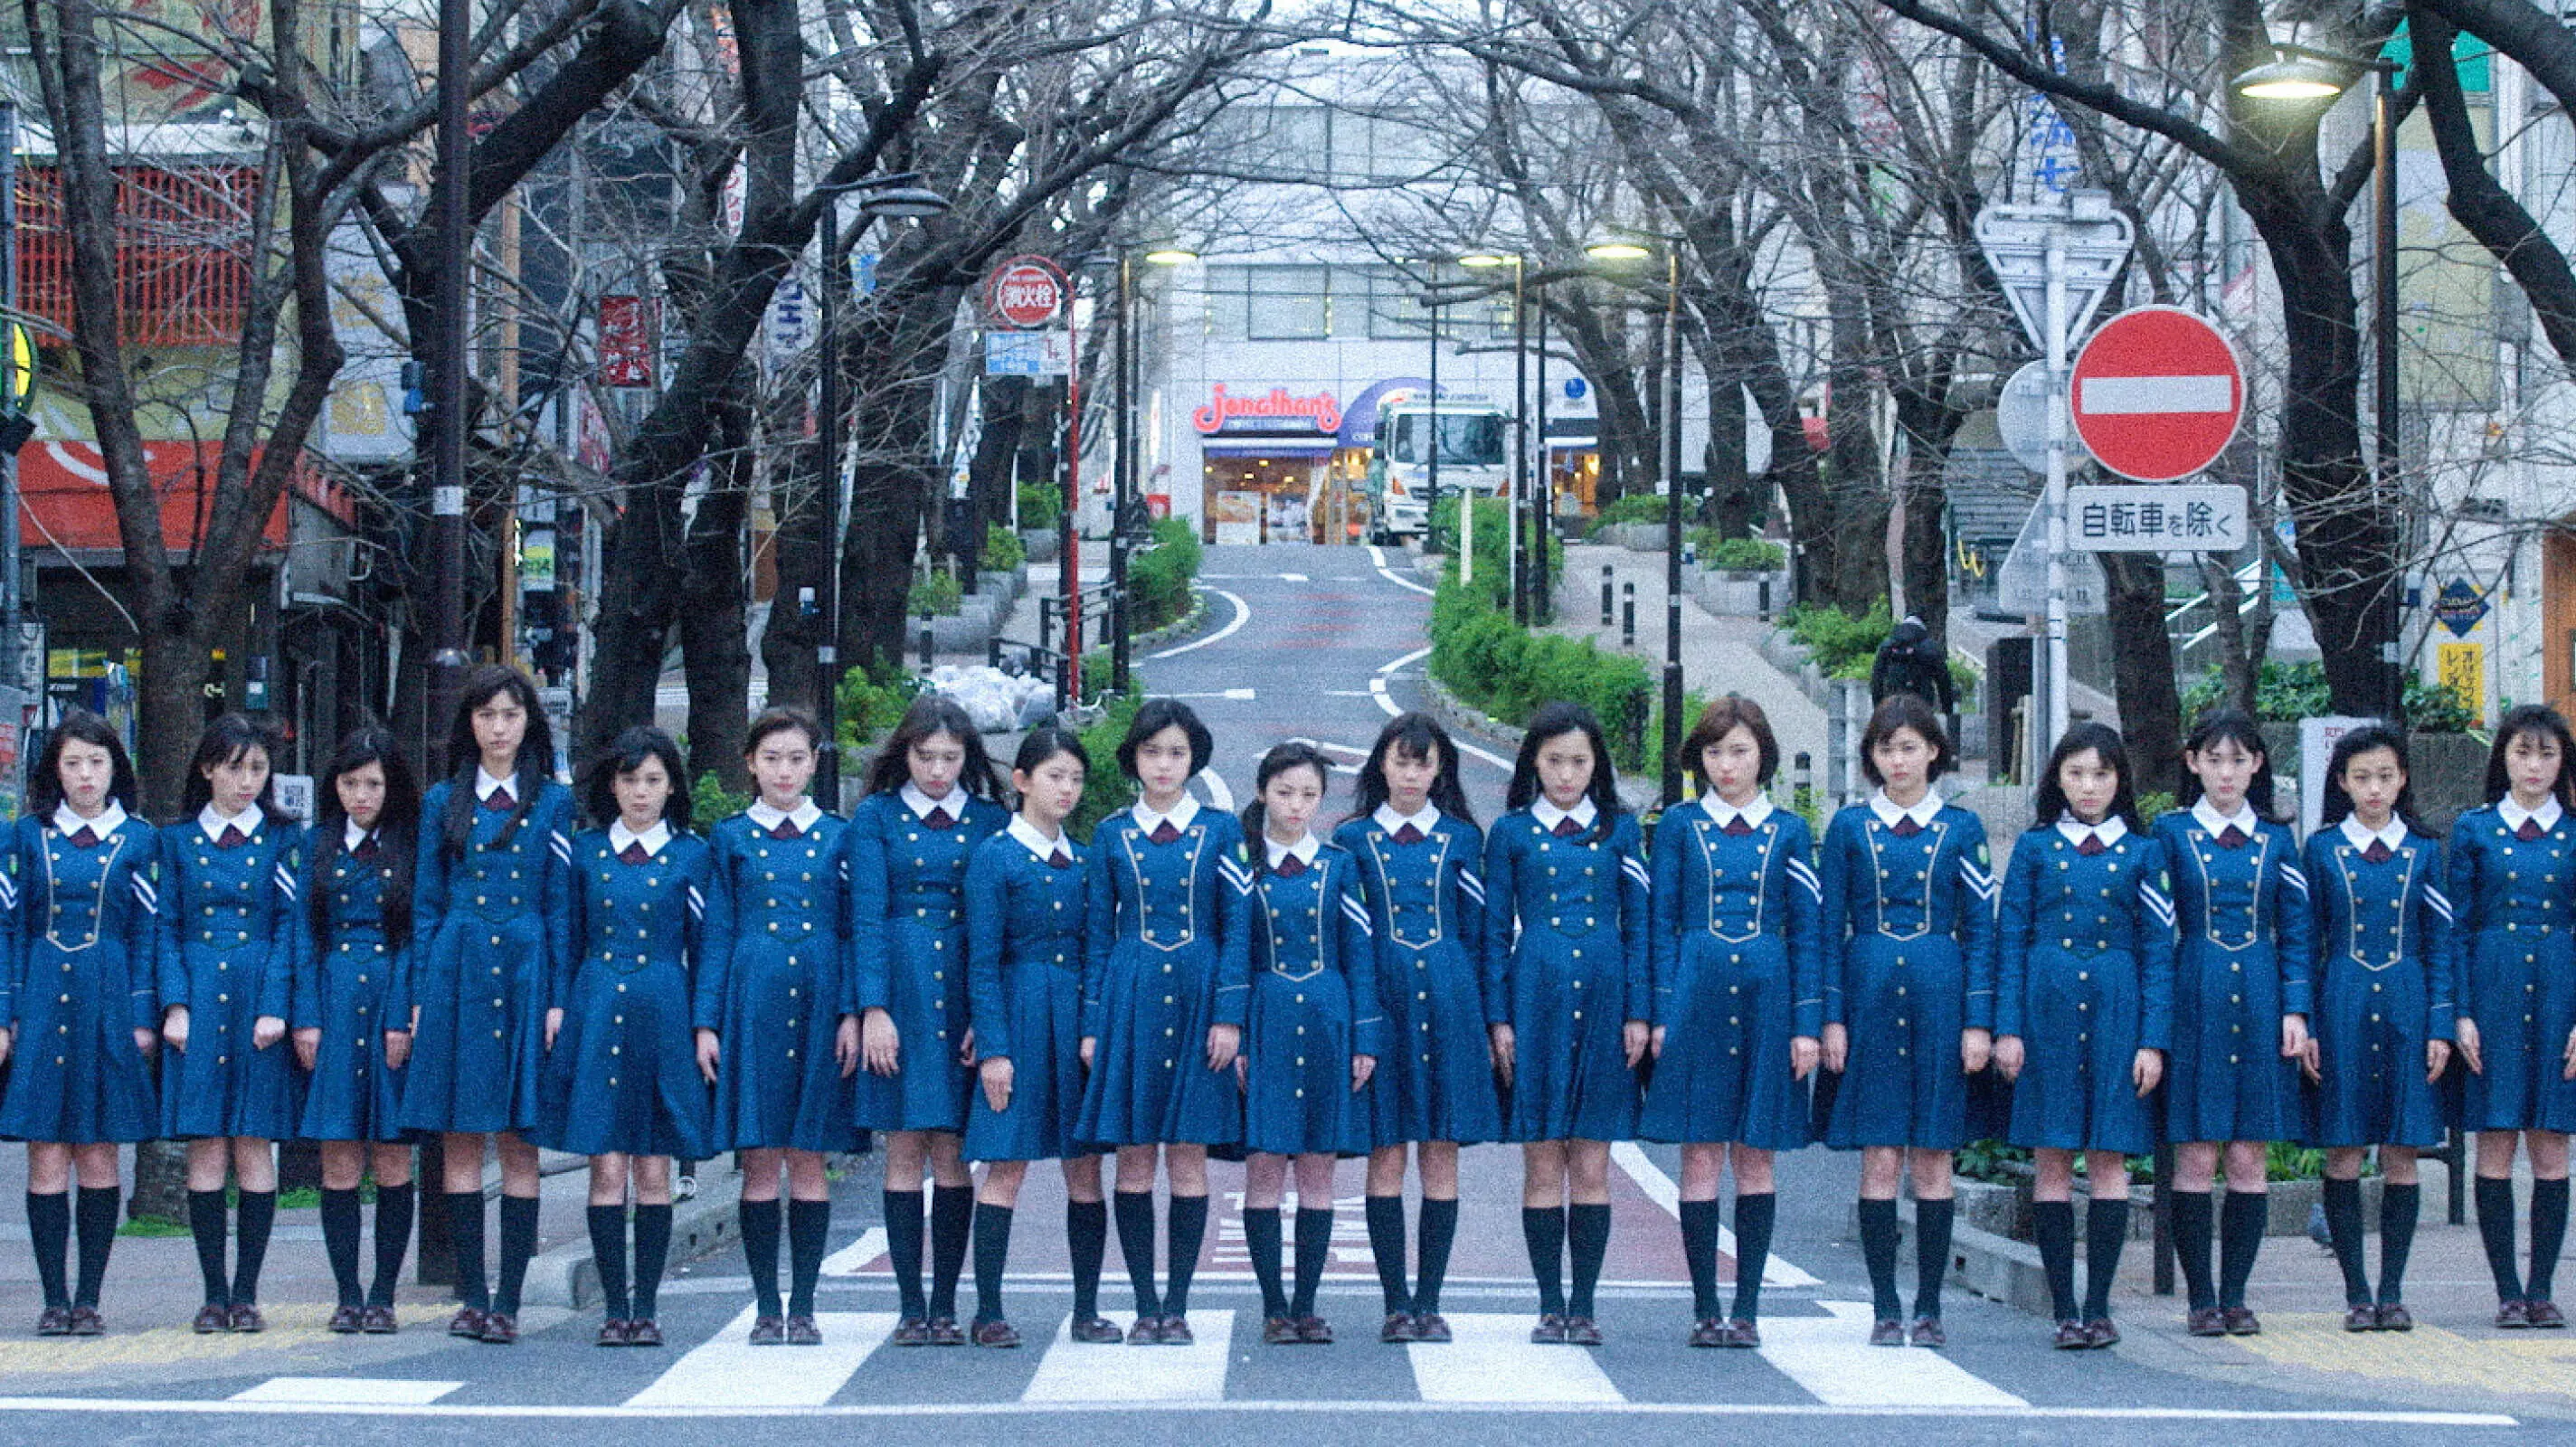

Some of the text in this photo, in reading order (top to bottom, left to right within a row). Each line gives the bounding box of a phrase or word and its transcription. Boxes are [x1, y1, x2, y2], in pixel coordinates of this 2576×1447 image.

[1005, 283, 1053, 308] 消火栓
[2082, 501, 2232, 538] 自転車を除く
